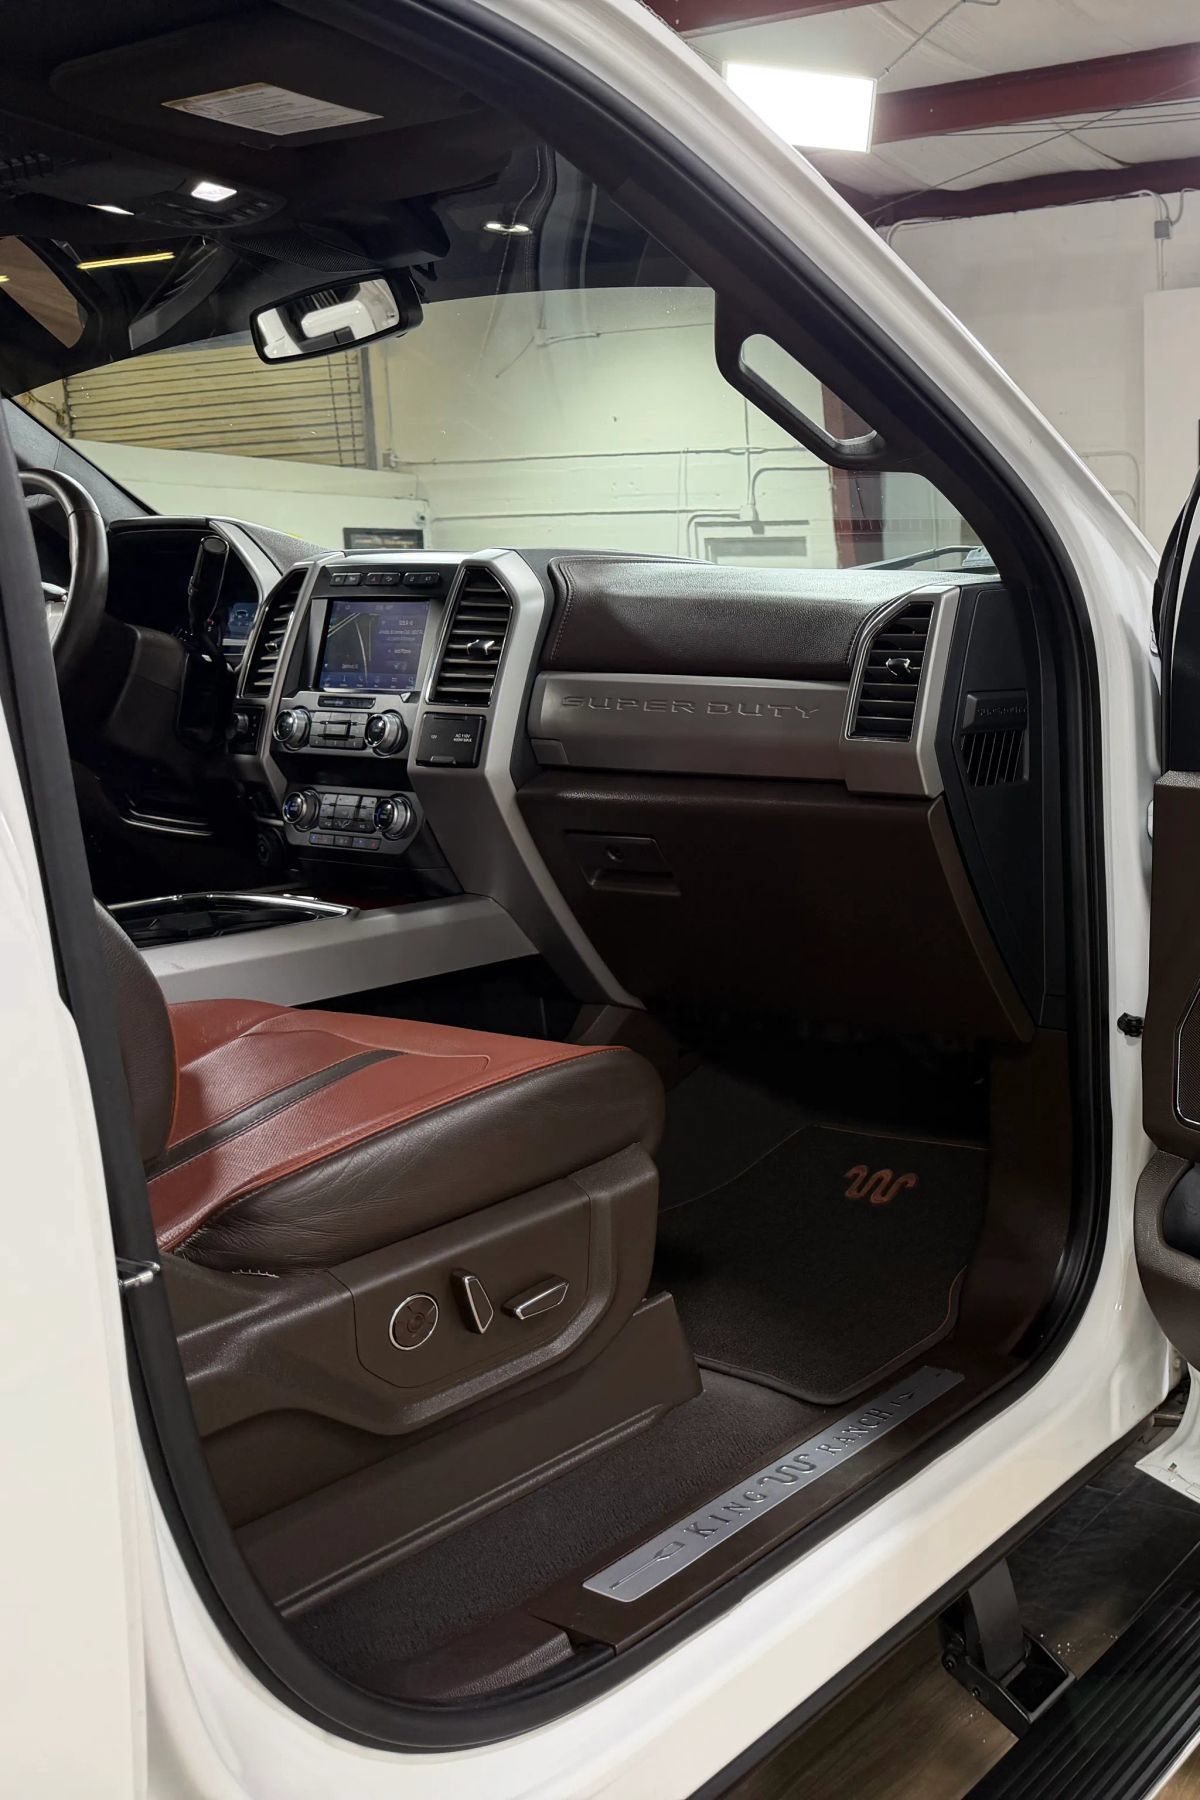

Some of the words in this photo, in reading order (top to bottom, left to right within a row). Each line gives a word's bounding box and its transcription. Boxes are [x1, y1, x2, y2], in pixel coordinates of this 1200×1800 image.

[562, 696, 695, 714] SUPER
[706, 702, 820, 719] DUTY
[684, 1489, 767, 1539] KING
[815, 1407, 894, 1457] RANCH
